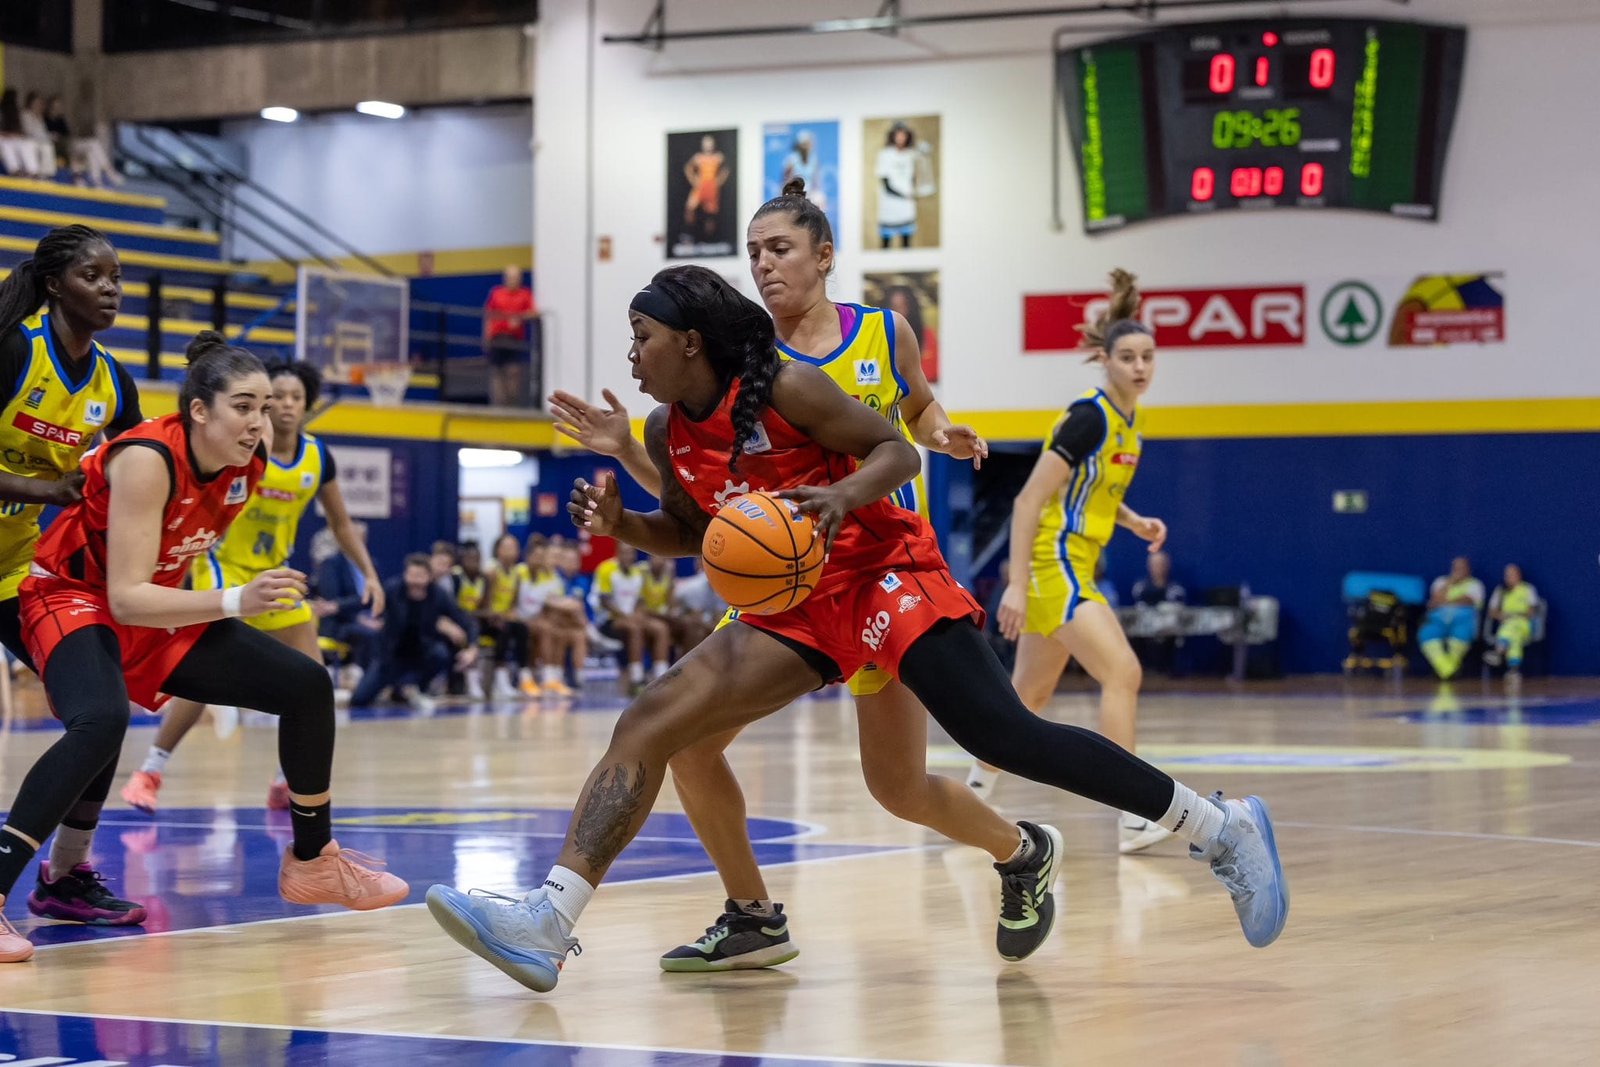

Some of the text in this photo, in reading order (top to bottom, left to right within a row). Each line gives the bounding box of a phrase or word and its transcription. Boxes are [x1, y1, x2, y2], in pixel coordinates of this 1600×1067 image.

[1209, 53, 1235, 94] 0
[1255, 56, 1269, 87] 1
[1309, 48, 1335, 89] 0
[1212, 108, 1300, 149] 09:26
[1191, 166, 1214, 201] 0
[1301, 162, 1324, 196] 0
[31, 421, 81, 444] SPAR
